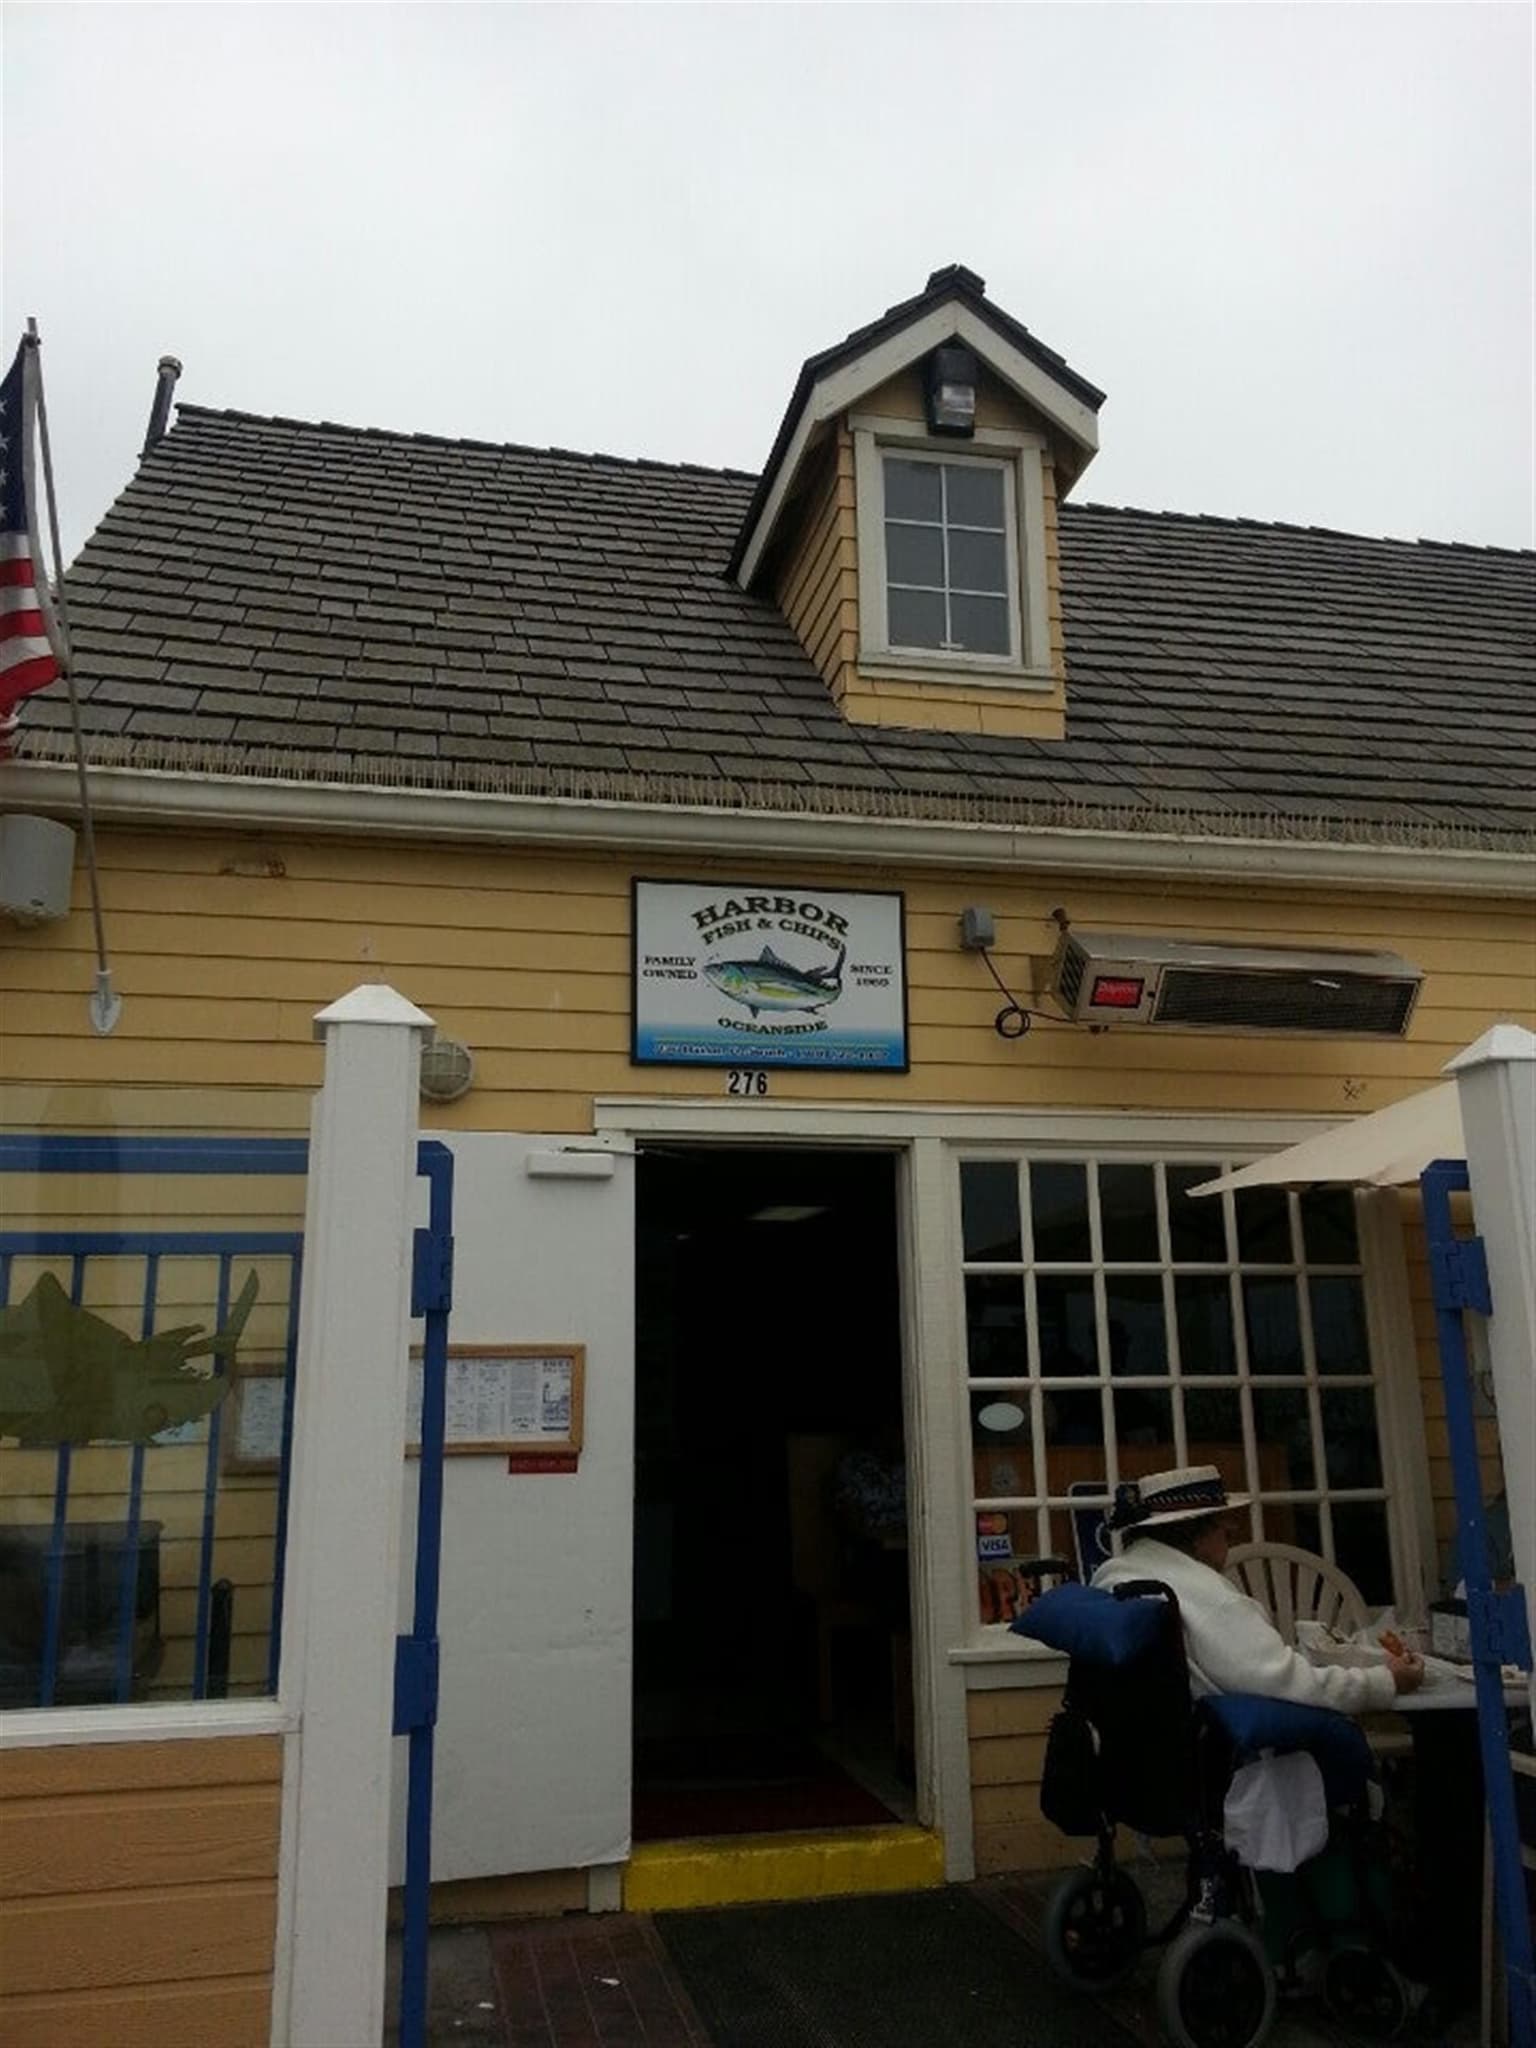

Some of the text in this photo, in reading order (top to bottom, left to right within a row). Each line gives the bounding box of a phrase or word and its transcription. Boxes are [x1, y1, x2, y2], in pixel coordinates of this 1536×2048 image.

[691, 896, 849, 937] HARBOR
[702, 918, 841, 950] FISH & CHIPS
[644, 956, 696, 966] FAMILY
[642, 969, 698, 980] OWNED
[850, 964, 893, 975] SINCE
[718, 1018, 828, 1035] OCEANSIDE
[728, 1070, 768, 1095] 276
[981, 1538, 1009, 1552] VISA
